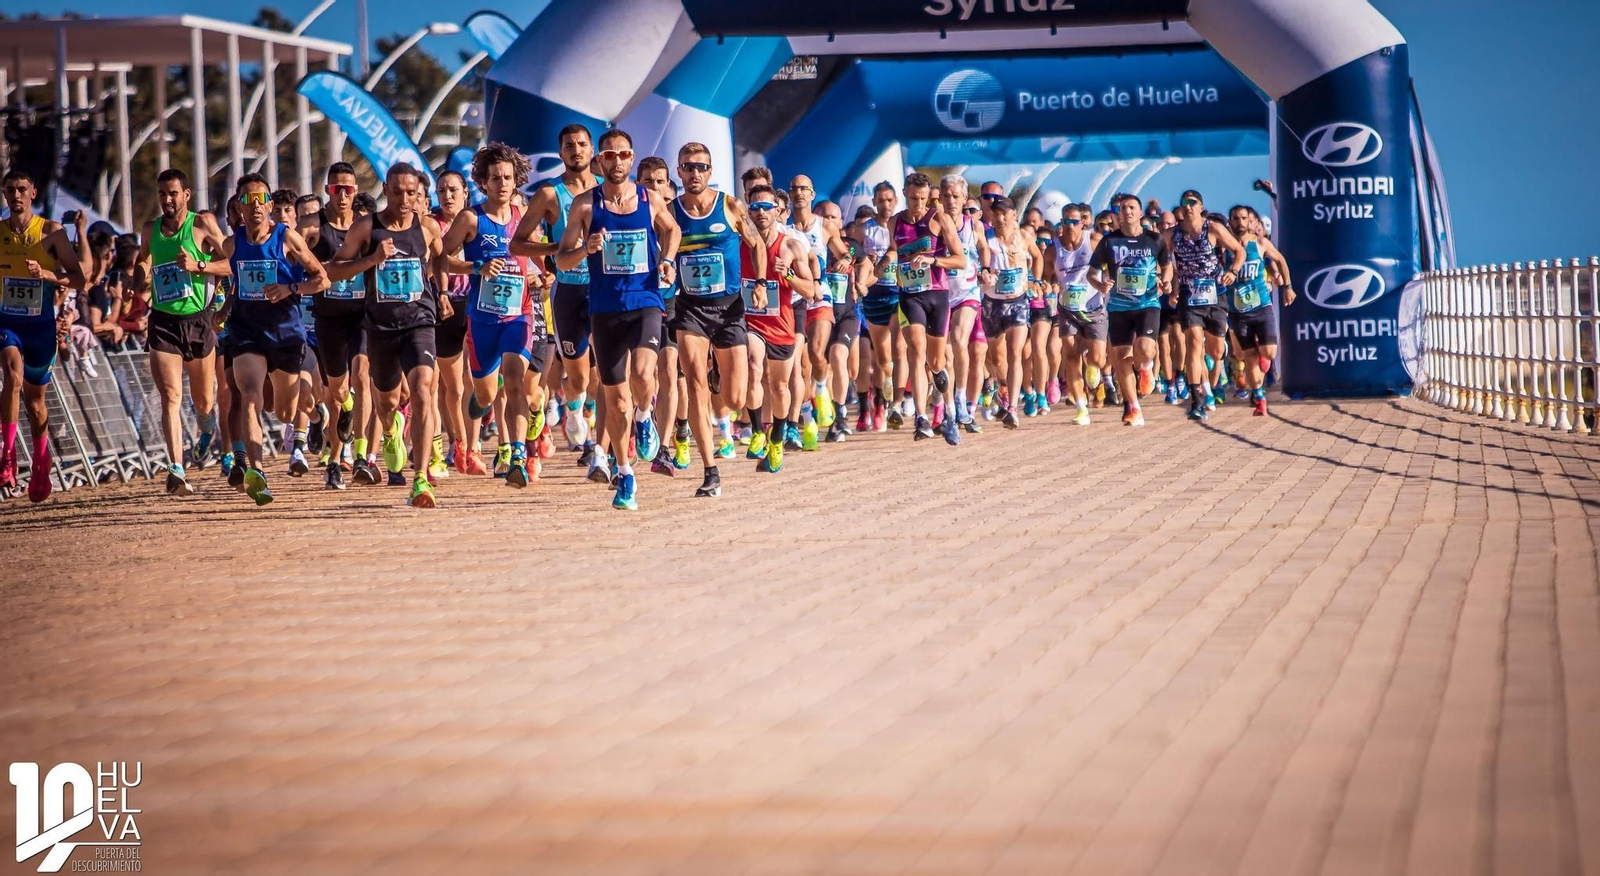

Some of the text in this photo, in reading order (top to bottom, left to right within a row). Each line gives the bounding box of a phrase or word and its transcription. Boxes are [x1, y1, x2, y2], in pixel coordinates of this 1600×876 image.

[1018, 83, 1219, 112] Puerto de Huelva
[1293, 177, 1395, 199] HYUNDAI
[1313, 201, 1374, 223] Syrluz
[616, 243, 636, 255] 27
[1128, 248, 1152, 257] HUELVA
[248, 271, 266, 283] 16
[390, 271, 410, 285] 31
[692, 265, 712, 278] 22
[904, 269, 925, 281] 139
[161, 272, 180, 286] 21
[1003, 275, 1016, 284] 28
[1125, 275, 1139, 284] 93
[8, 286, 34, 299] 151
[492, 284, 512, 298] 25
[1069, 291, 1082, 300] 47
[1296, 319, 1398, 341] HYUNDAI
[1317, 344, 1378, 366] Syrluz
